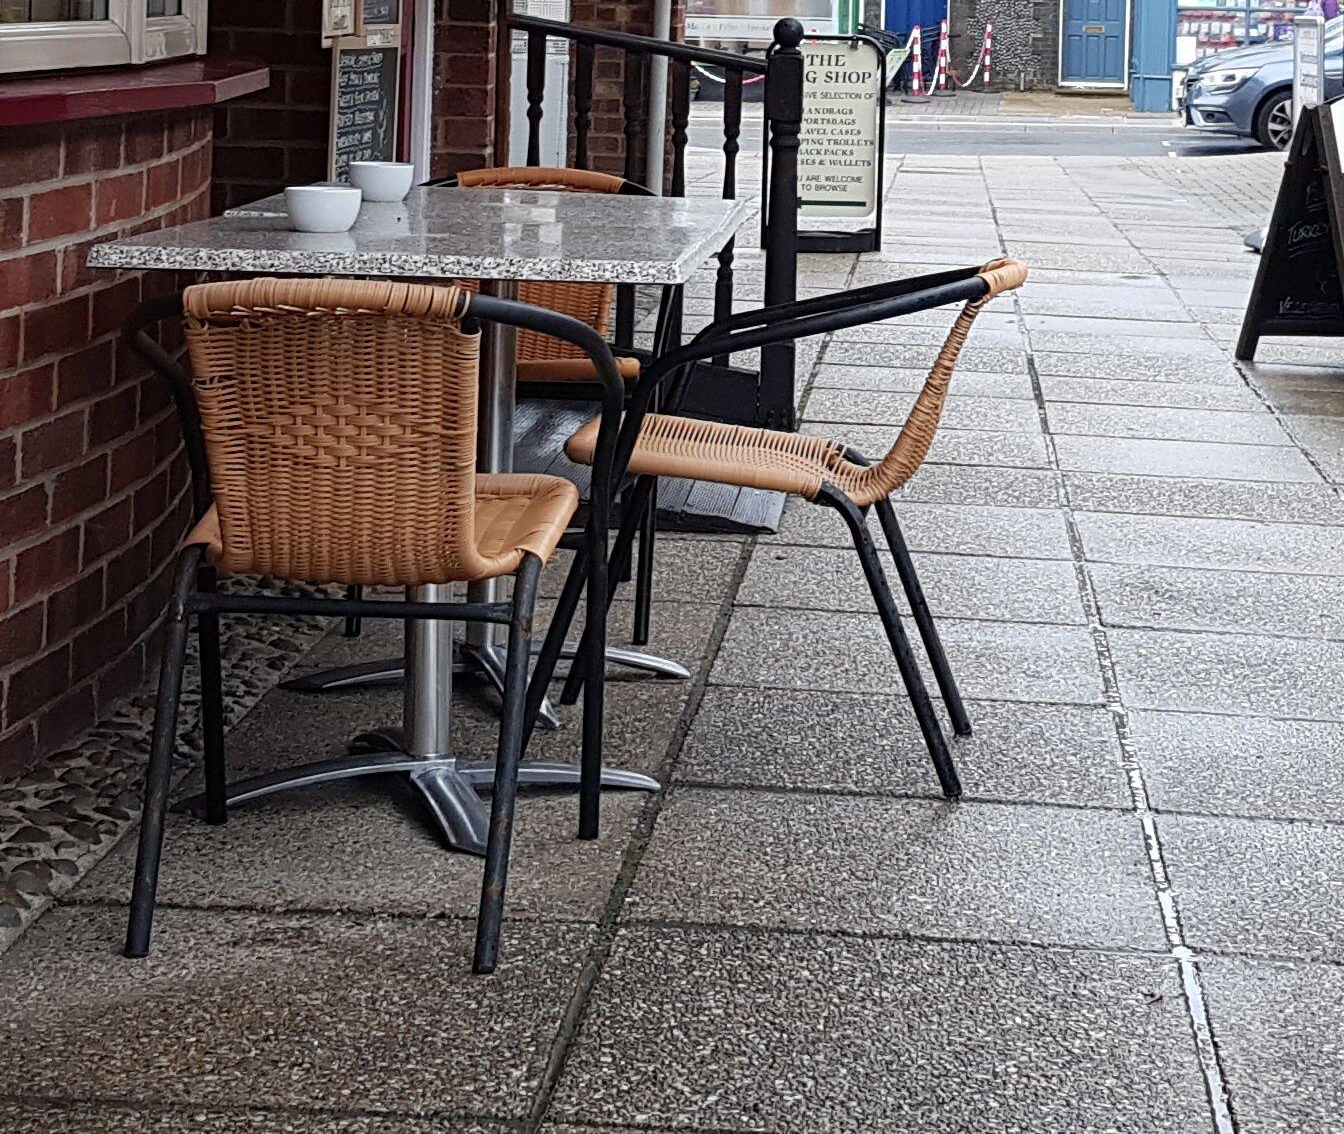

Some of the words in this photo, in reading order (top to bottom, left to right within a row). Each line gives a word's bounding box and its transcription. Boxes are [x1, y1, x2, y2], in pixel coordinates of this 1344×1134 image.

[806, 54, 846, 67] THE
[824, 71, 872, 84] SHOP
[820, 91, 862, 101] SELECTION
[863, 92, 875, 101] OF
[804, 108, 854, 116] ANDBAGS
[830, 128, 862, 136] CASES
[825, 138, 875, 147] TROLLEYS
[829, 159, 872, 167] WALLETS
[805, 174, 822, 183] ARE
[824, 175, 864, 184] WELCOME
[801, 183, 813, 192] TO
[814, 184, 848, 193] BROWSE
